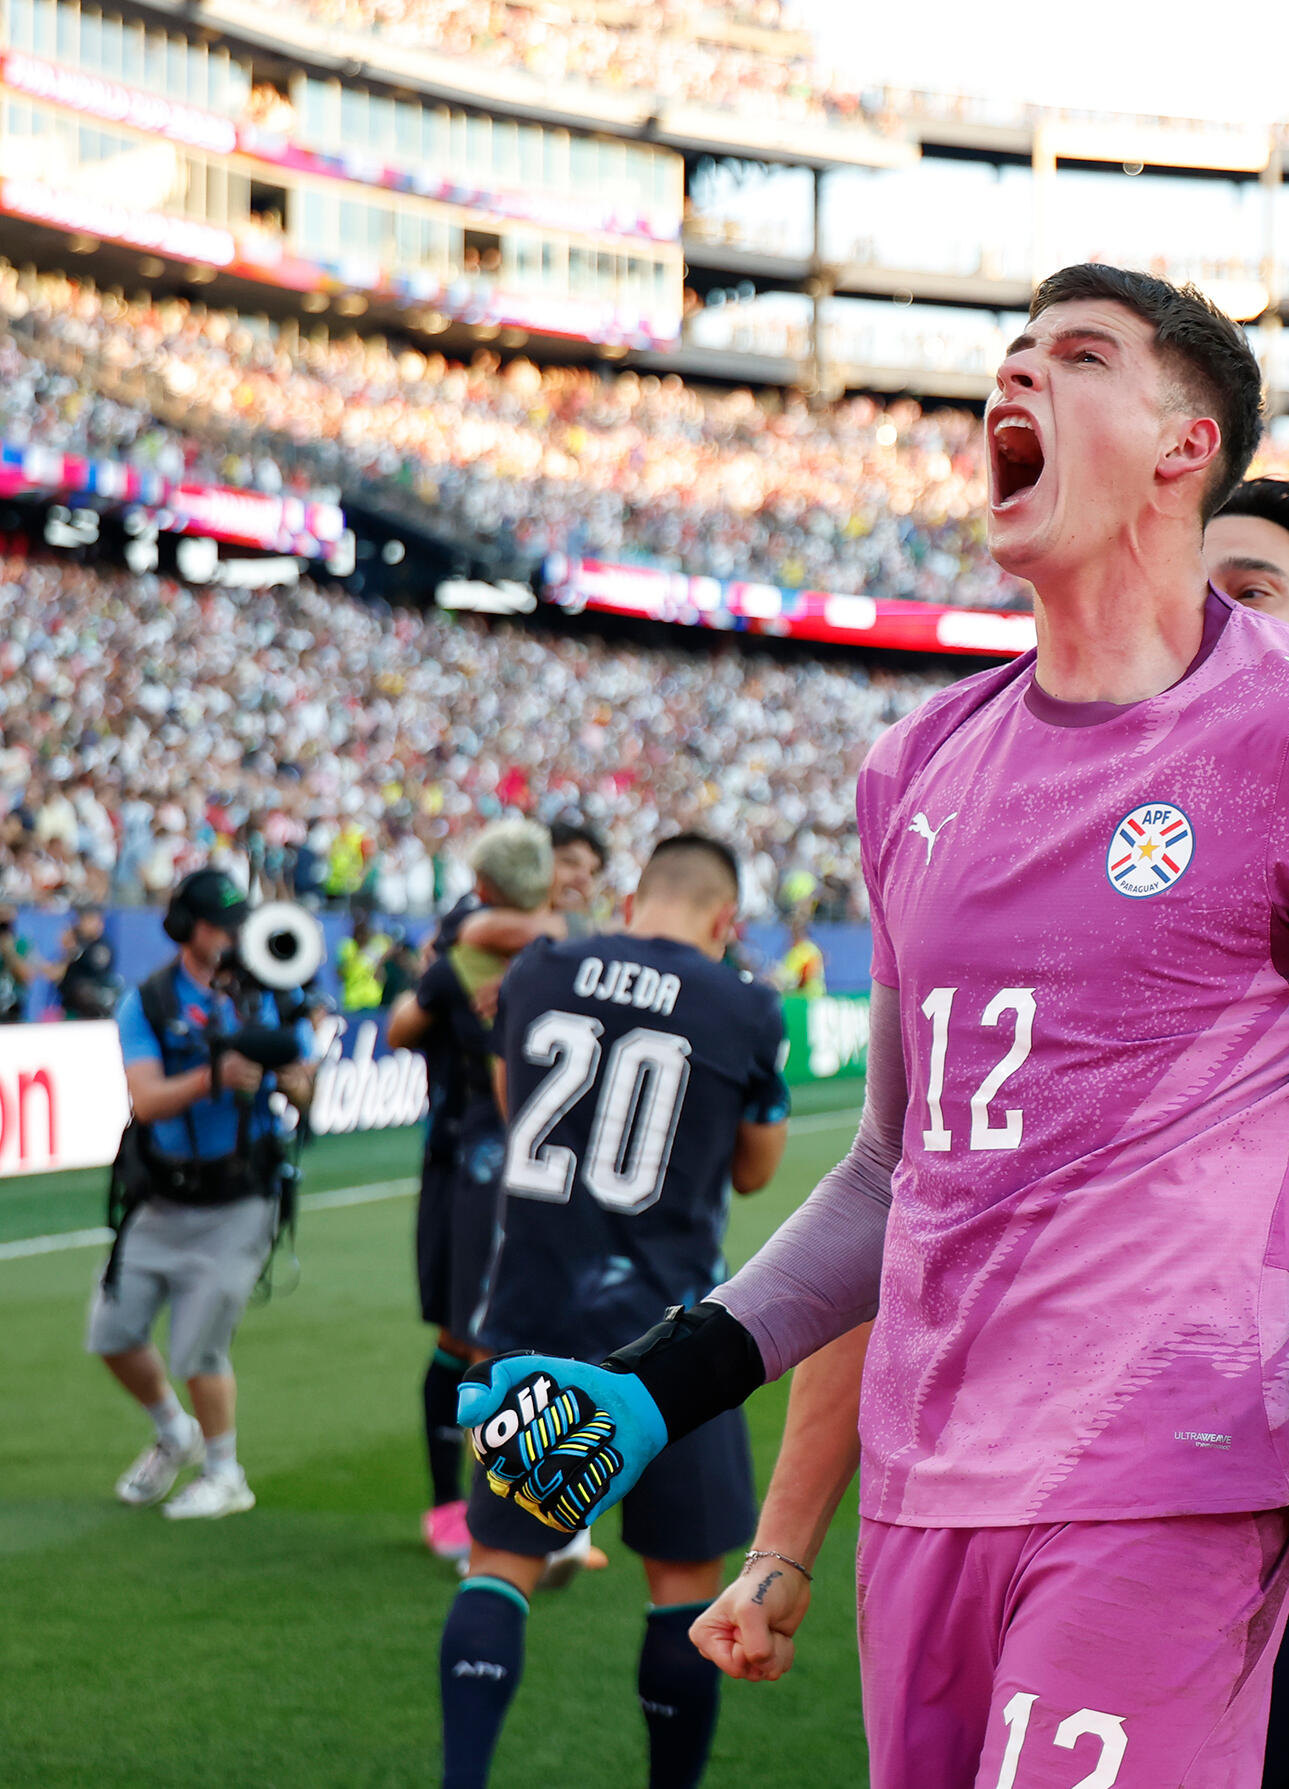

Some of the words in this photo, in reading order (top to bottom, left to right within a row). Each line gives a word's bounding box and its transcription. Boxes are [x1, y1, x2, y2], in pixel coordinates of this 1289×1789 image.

[1142, 810, 1172, 825] APF
[1120, 880, 1159, 893] PARAGUAY
[574, 957, 681, 1016] OJEDA
[921, 987, 1037, 1151] 12
[505, 1009, 692, 1216] 20
[1174, 1431, 1232, 1445] ULTRAWEAVE
